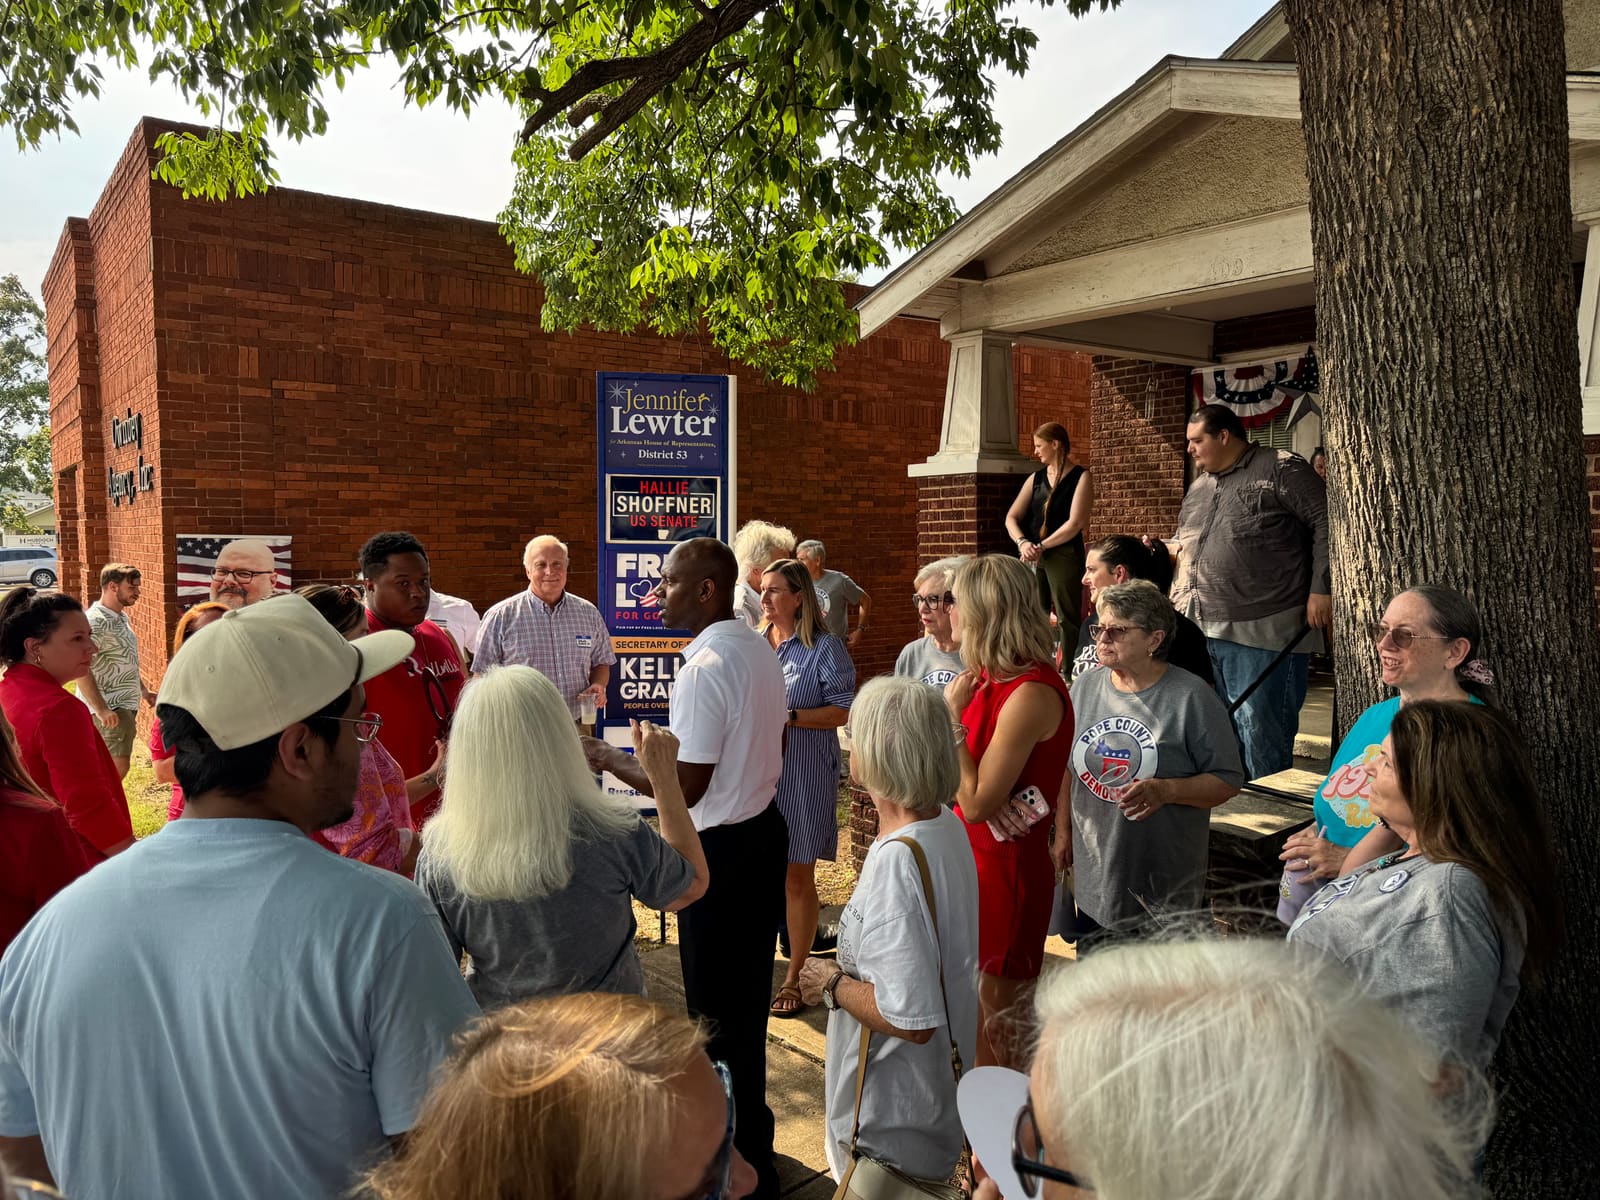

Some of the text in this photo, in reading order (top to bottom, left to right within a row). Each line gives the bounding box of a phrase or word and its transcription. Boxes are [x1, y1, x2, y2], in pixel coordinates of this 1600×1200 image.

[623, 388, 710, 414] Jennifer
[611, 406, 717, 436] Lewter
[638, 449, 688, 460] District 53
[640, 480, 689, 495] HALLIE
[616, 495, 711, 514] SHOFFNER
[630, 515, 698, 528] US SENATE
[615, 611, 639, 620] FOR
[615, 640, 669, 649] SECRETARY
[670, 640, 684, 649] OF
[1081, 718, 1155, 750] POPE COUNTY
